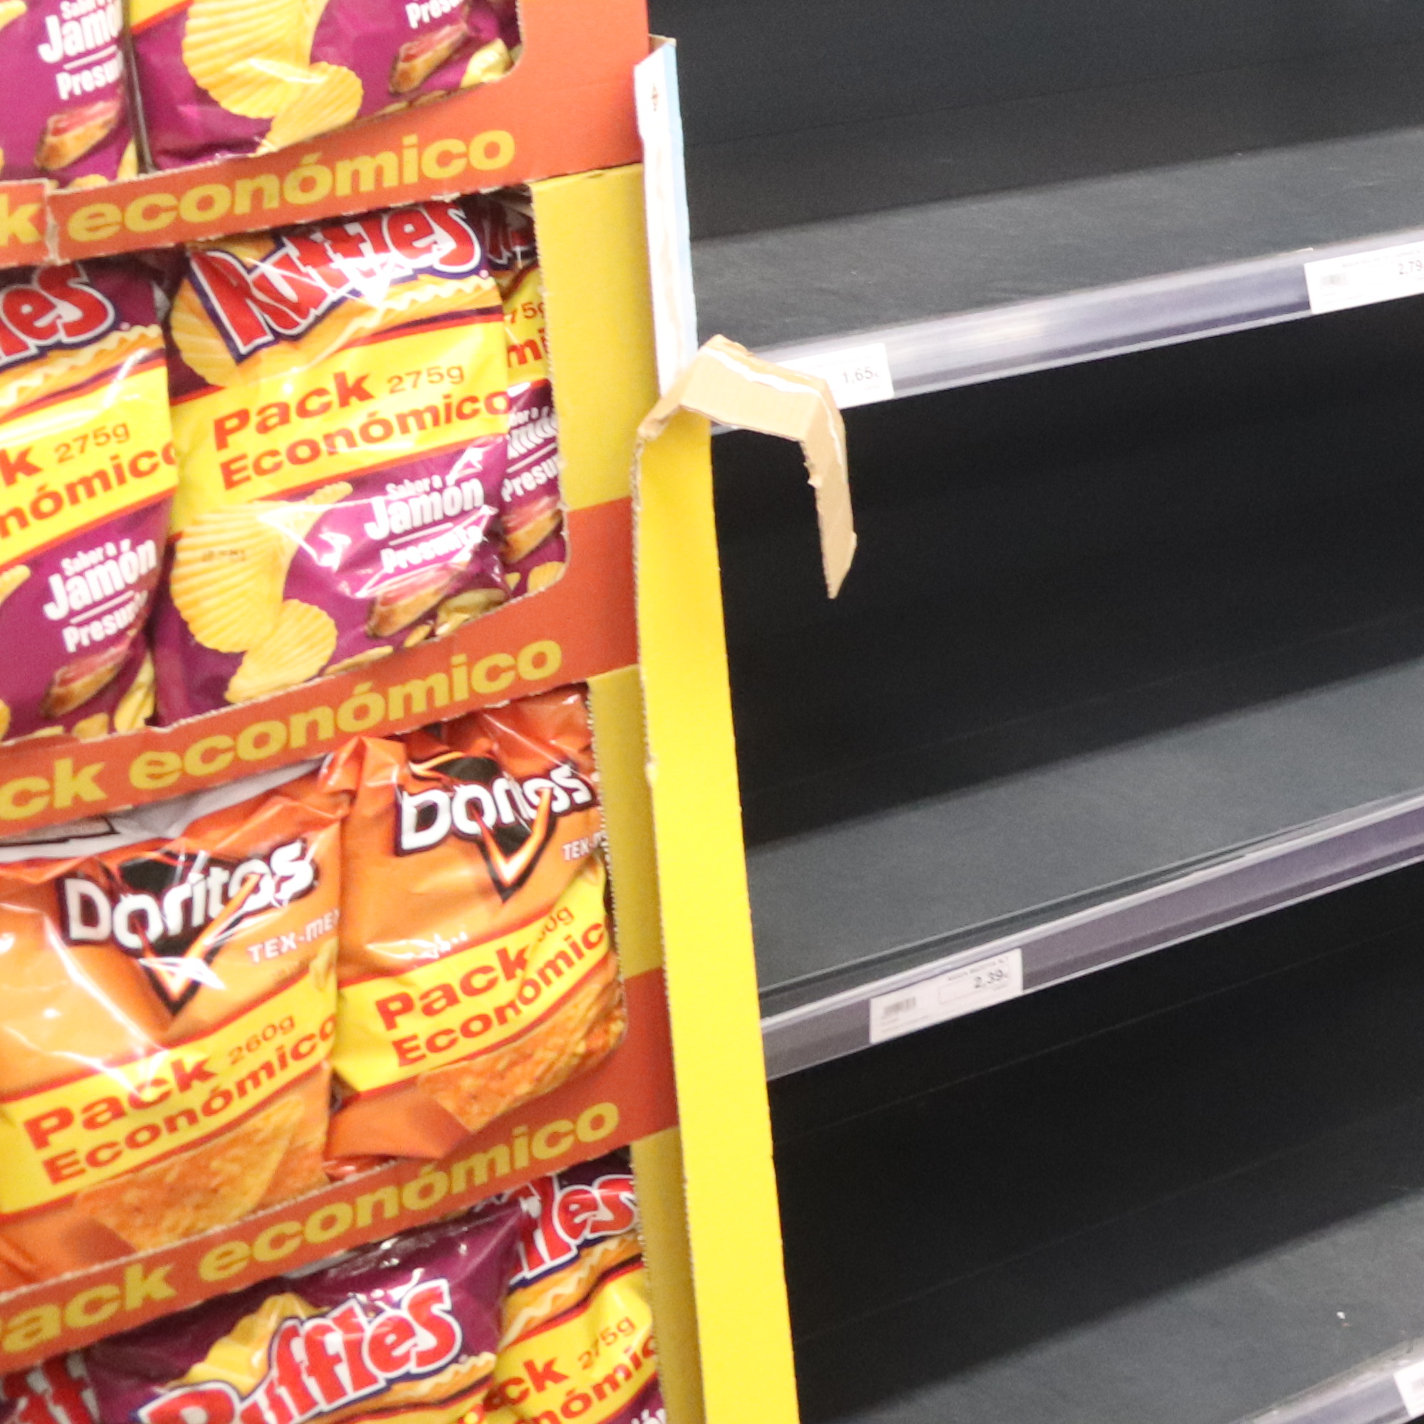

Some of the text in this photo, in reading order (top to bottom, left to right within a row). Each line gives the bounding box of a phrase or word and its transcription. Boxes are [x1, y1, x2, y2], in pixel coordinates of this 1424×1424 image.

[66, 127, 516, 243] económico
[190, 199, 484, 356] Ruffles
[53, 420, 131, 464] 275g
[213, 365, 465, 452] Pack 275g
[220, 390, 513, 492] Económico
[363, 470, 486, 541] Jamón
[43, 539, 158, 621] Jamón
[61, 544, 103, 577] Sabor
[128, 638, 563, 788] económico
[64, 840, 316, 952] Doritos
[375, 942, 532, 1032] Pack
[23, 1014, 296, 1151] Pack 260g
[199, 1100, 620, 1282] económico
